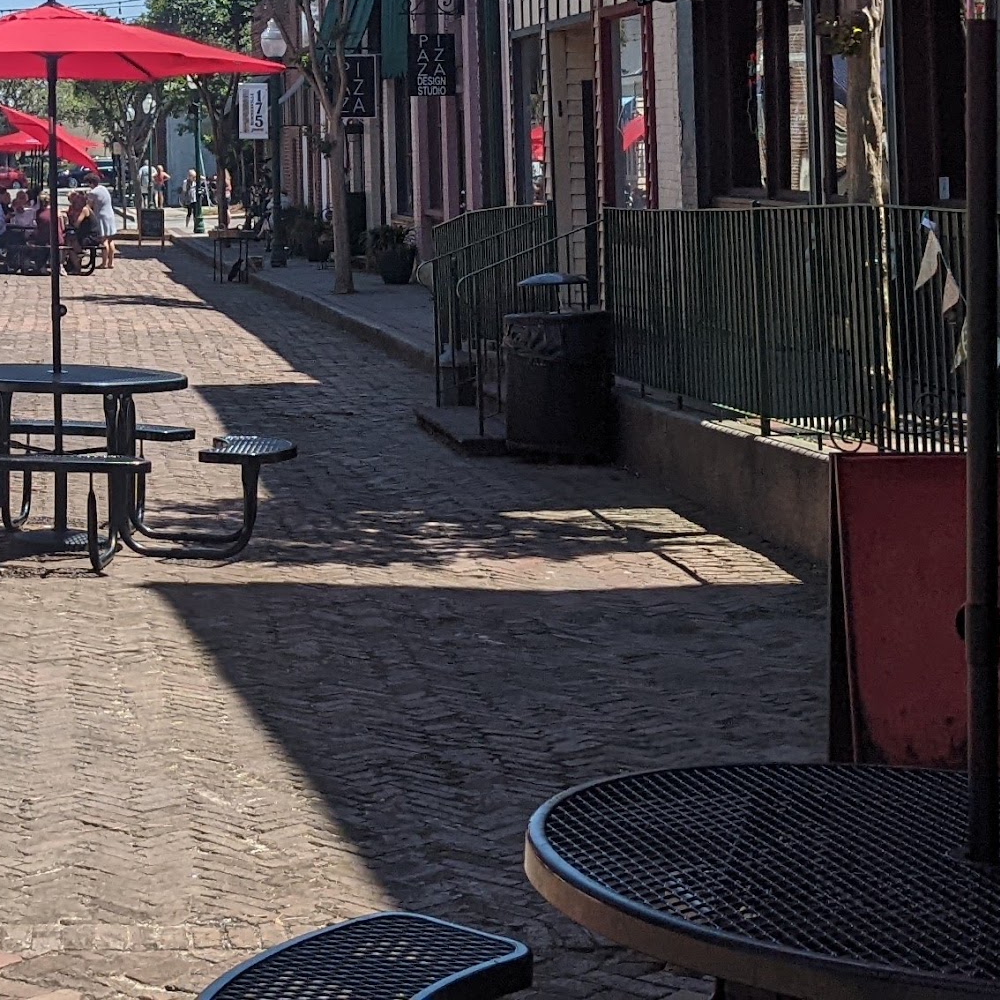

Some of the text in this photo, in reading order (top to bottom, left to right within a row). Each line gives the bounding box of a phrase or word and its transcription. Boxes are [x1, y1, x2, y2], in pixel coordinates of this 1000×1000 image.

[417, 76, 447, 86] DESIGN
[417, 86, 447, 96] STUDIO
[254, 89, 264, 128] 175
